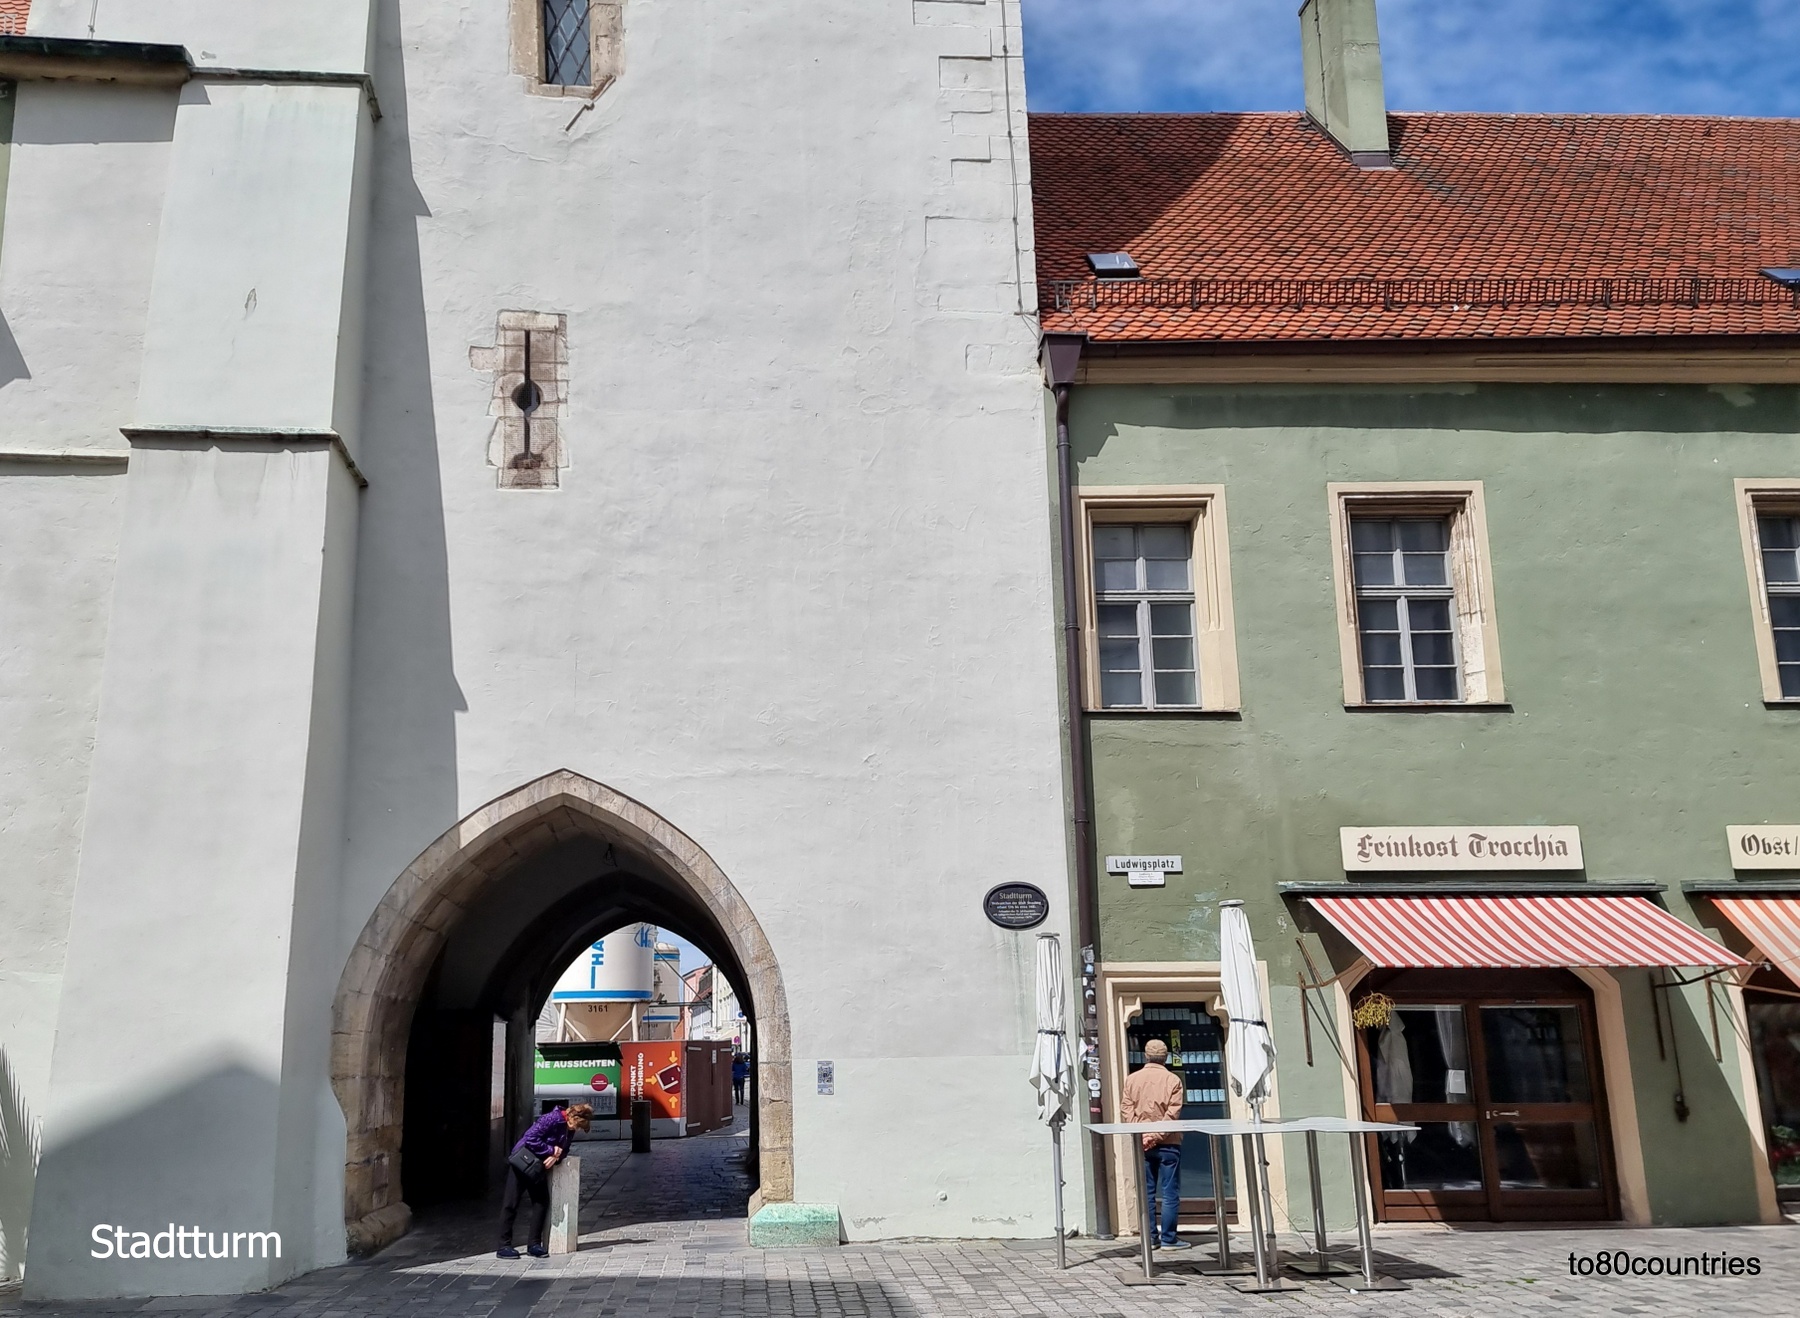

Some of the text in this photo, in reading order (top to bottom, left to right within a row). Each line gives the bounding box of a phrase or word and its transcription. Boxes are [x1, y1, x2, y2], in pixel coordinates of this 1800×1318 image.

[1357, 833, 1569, 862] Feinkost Trocchia
[1115, 859, 1175, 870] Ludwigsplatz
[588, 1005, 608, 1013] 3161
[535, 1059, 616, 1069] NE AUSSICHTEN
